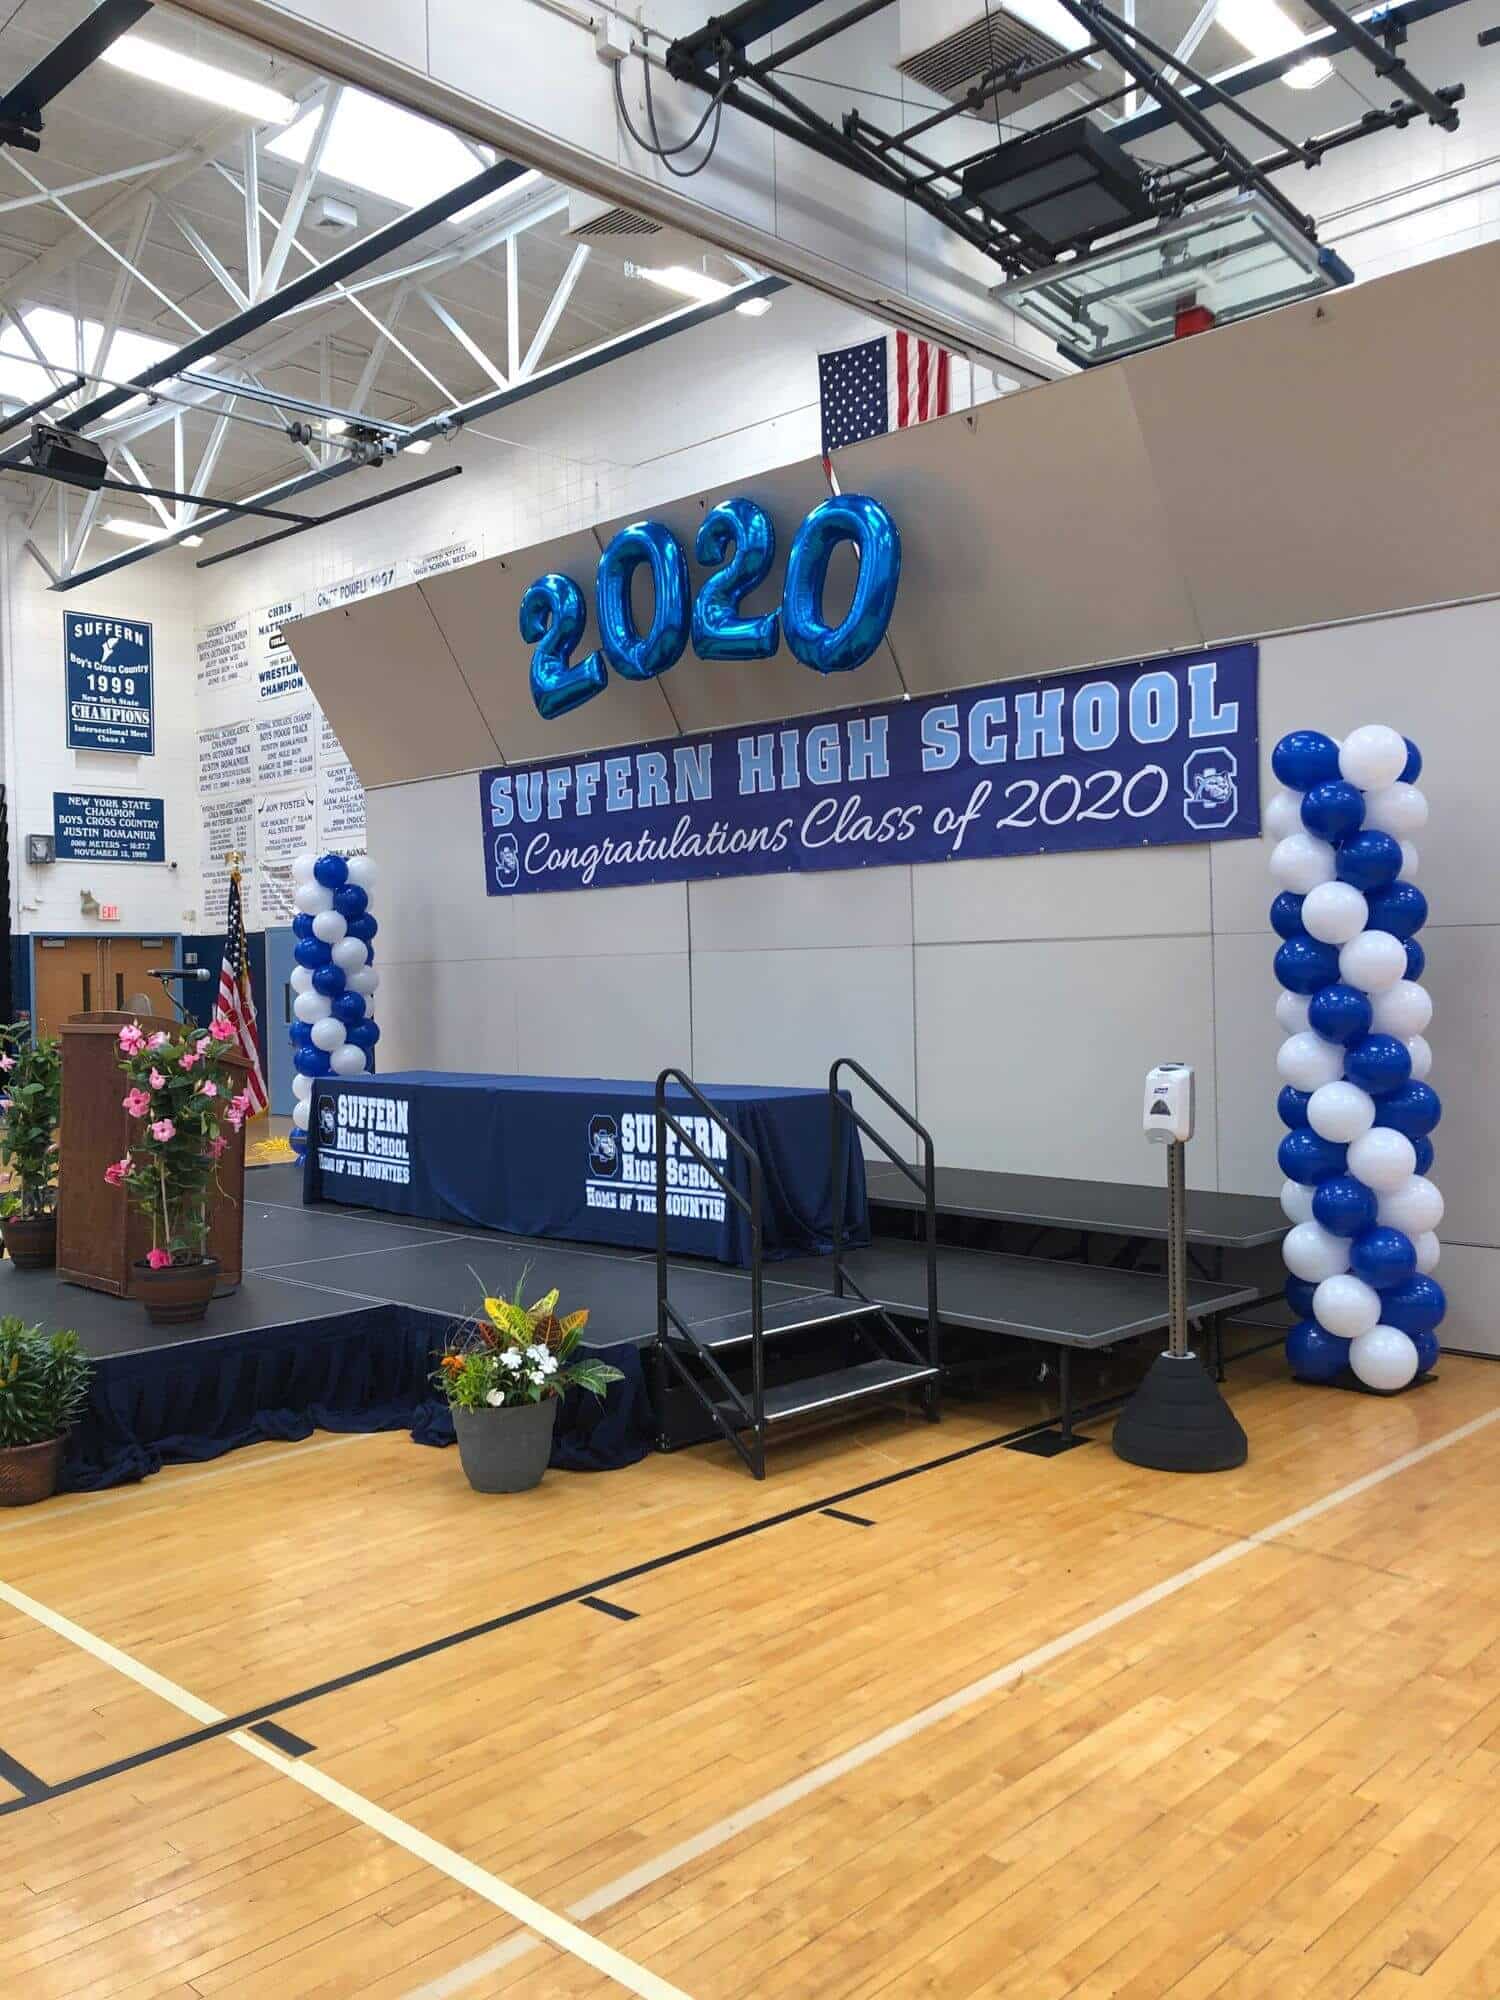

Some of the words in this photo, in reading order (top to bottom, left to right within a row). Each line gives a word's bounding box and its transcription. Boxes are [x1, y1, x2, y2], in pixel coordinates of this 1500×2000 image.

[267, 603, 292, 618] CHRIS
[519, 493, 900, 720] 2020
[74, 621, 144, 646] SUFFERN
[70, 652, 92, 670] Boy's
[94, 661, 117, 674] Cross
[118, 663, 149, 675] Country
[87, 674, 135, 695] 1999
[260, 677, 303, 697] CHAMPION
[82, 694, 98, 702] New
[99, 694, 116, 704] York
[118, 697, 139, 707] State
[71, 703, 150, 725] CHAMPIONS
[97, 734, 117, 744] Class
[491, 743, 713, 827] SUFFERN
[737, 715, 891, 795] HIGH
[921, 662, 1239, 773] SCHOOL
[68, 796, 89, 806] NEW
[94, 798, 118, 808] YORK
[122, 800, 152, 810] STATE
[85, 807, 135, 818] CHAMPION
[59, 815, 83, 825] BOYS
[86, 816, 116, 826] CROSS
[119, 819, 160, 829] COUNTRY
[523, 814, 793, 884] Congratulations
[800, 794, 922, 848] Class
[933, 780, 993, 851] of
[995, 764, 1169, 830] 2020
[63, 826, 99, 837] JUSTIN
[103, 829, 156, 841] ROMANIUK
[74, 848, 118, 857] NOVEMBER
[88, 840, 120, 849] METERS
[337, 1094, 409, 1134] SUFFERN
[336, 1127, 365, 1152] HIGH
[367, 1131, 410, 1159] SCHOOL
[336, 1159, 346, 1174] OF
[346, 1161, 362, 1176] THE
[363, 1159, 410, 1184] MOUNTIES
[666, 1157, 724, 1190] SCHOO
[586, 1186, 617, 1209] HOME
[619, 1193, 633, 1211] OF
[636, 1194, 657, 1214] THE
